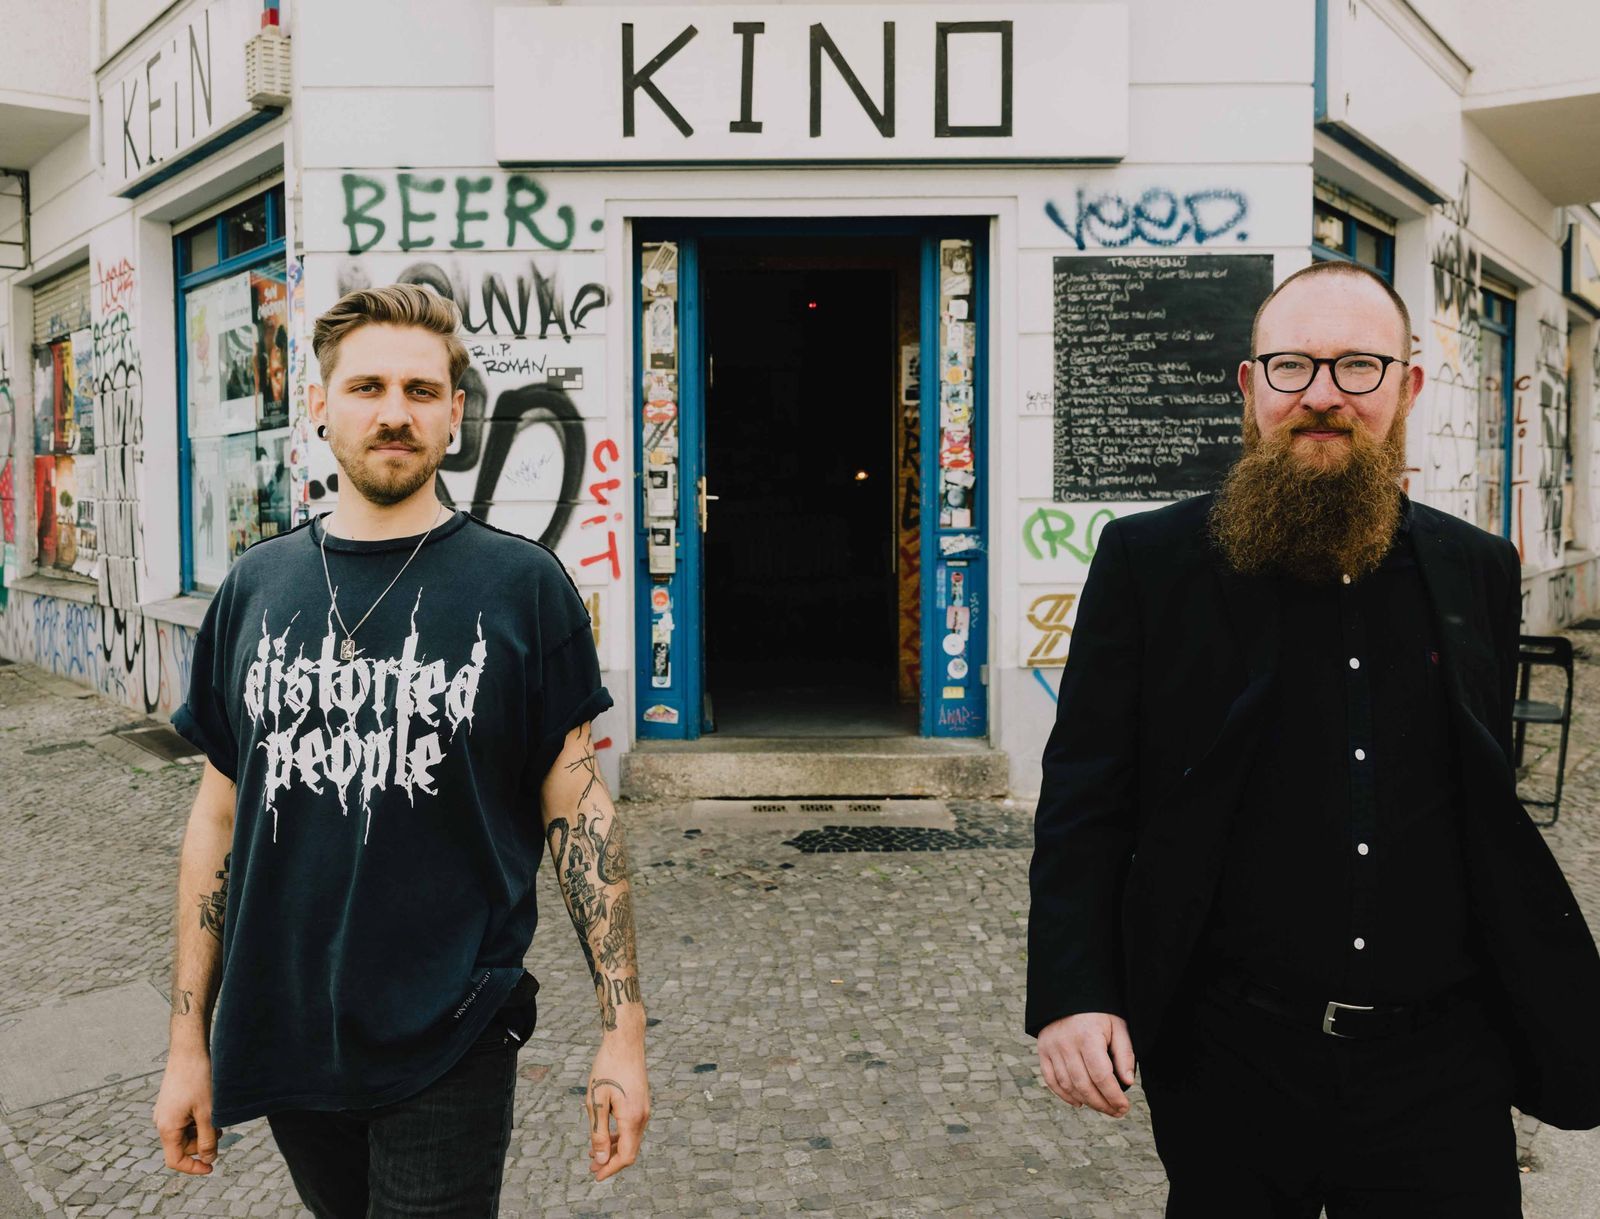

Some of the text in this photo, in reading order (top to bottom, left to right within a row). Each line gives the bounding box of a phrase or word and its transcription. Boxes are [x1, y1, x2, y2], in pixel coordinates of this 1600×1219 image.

[620, 20, 1014, 138] KINO
[1107, 255, 1188, 269] TAGESMENÜ
[482, 354, 547, 375] ROMAN
[244, 588, 487, 742] distorted
[257, 725, 447, 842] people
